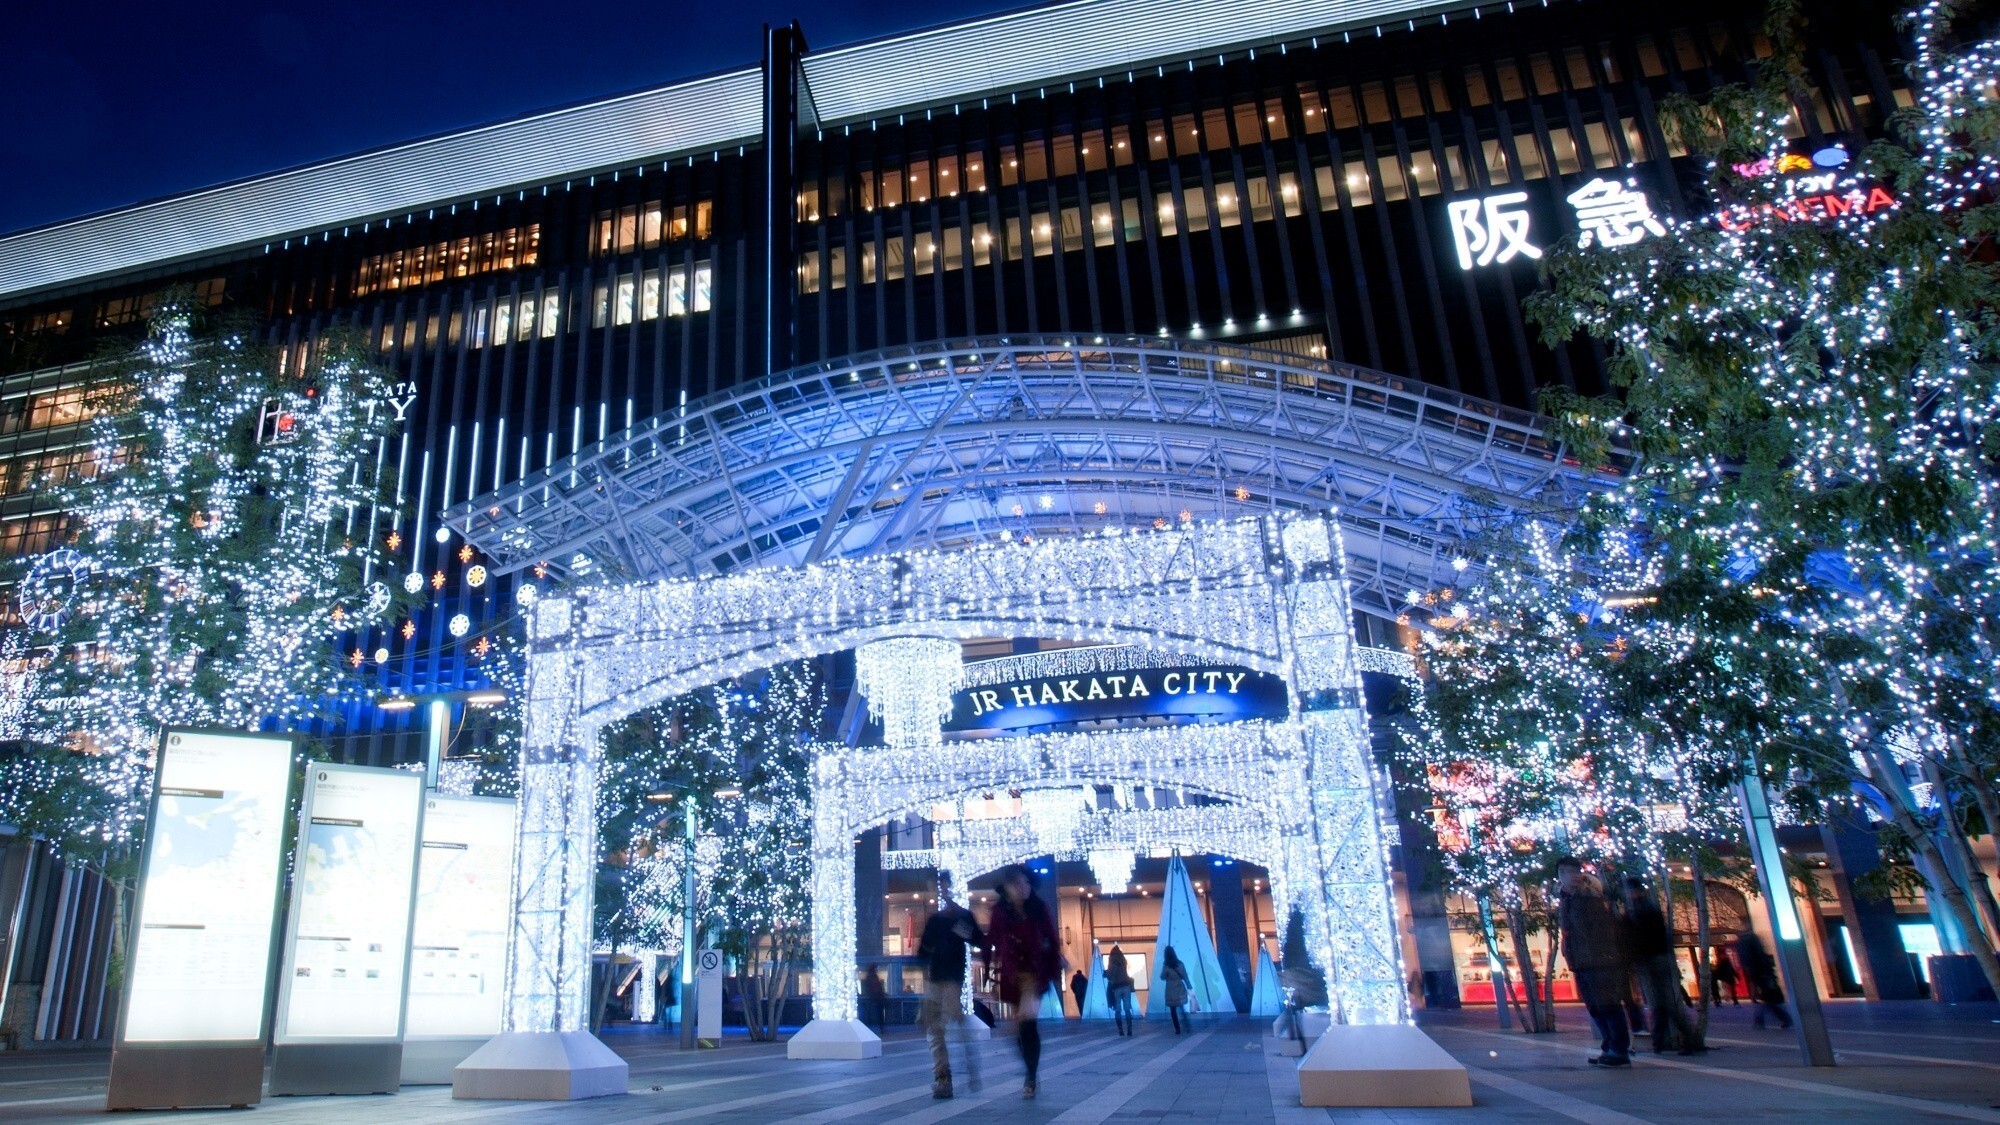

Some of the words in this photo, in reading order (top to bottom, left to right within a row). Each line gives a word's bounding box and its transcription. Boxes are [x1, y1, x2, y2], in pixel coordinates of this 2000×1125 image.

[1448, 177, 1666, 271] 阪急
[969, 689, 1003, 717] JR
[1011, 674, 1150, 708] HAKATA
[1163, 671, 1246, 695] CITY
